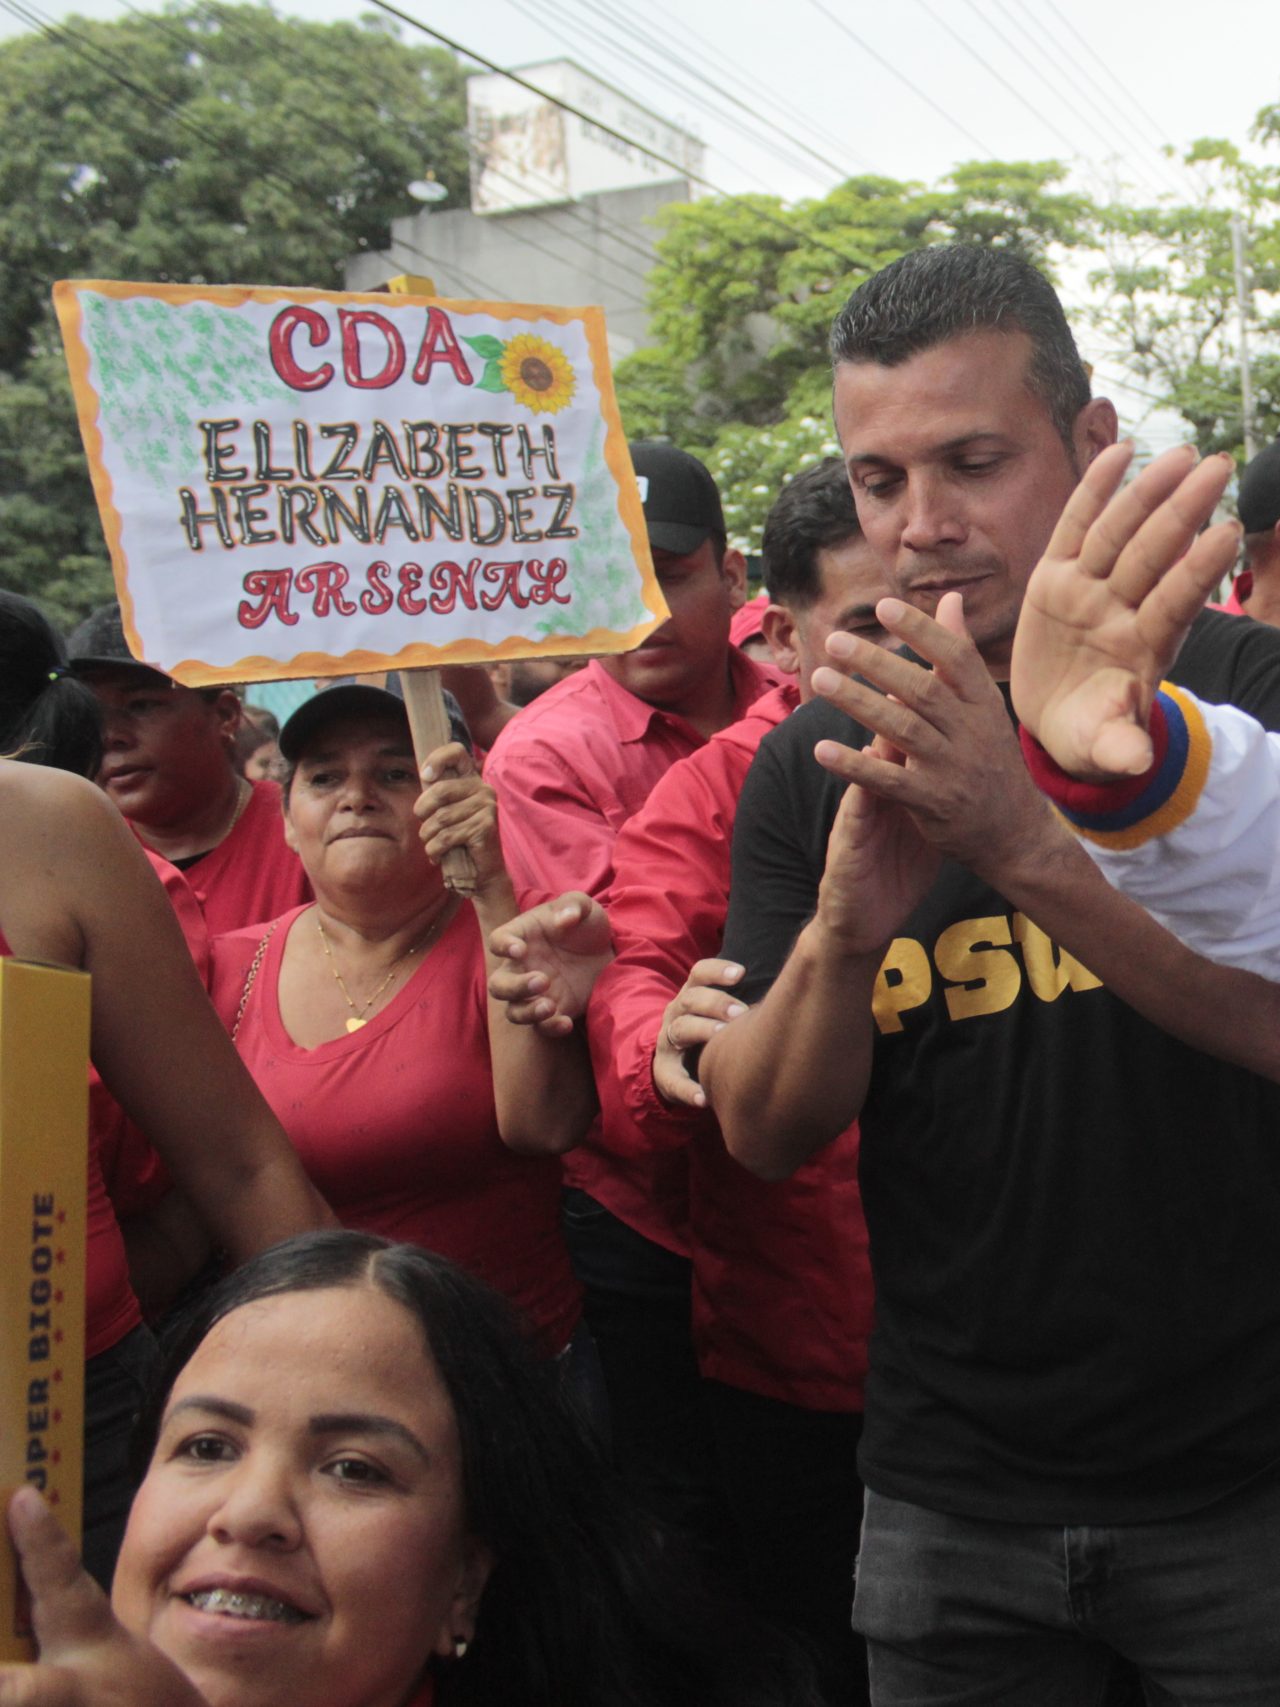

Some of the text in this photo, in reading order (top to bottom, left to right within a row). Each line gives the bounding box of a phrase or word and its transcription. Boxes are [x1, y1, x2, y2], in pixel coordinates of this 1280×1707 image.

[269, 305, 473, 392] CDA
[201, 419, 559, 483] ELIZABETH
[180, 482, 577, 551] HERNANDEZ
[237, 557, 572, 629] ARSENAL
[872, 911, 1104, 1034] PSU
[26, 1193, 54, 1491] UPER BIGOTE
